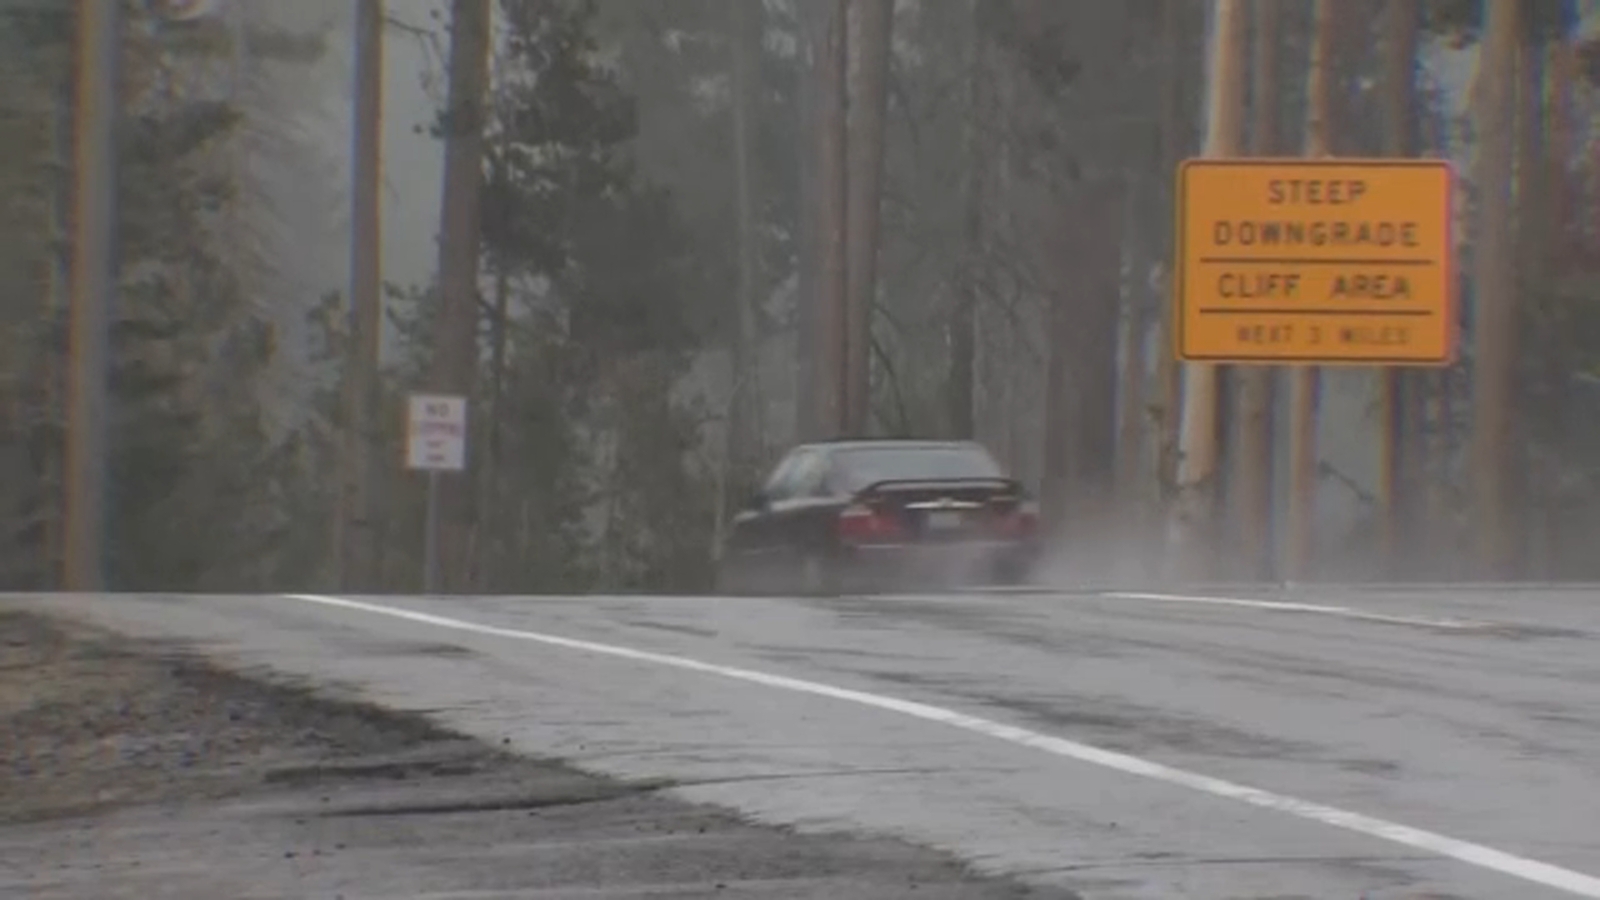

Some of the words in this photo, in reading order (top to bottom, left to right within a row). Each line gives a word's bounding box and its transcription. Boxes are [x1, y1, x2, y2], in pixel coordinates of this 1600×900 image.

[1267, 179, 1367, 205] STEEP
[1213, 220, 1420, 247] DOWNGRADE
[1218, 272, 1301, 299] CLIFF
[1330, 273, 1412, 300] AREA
